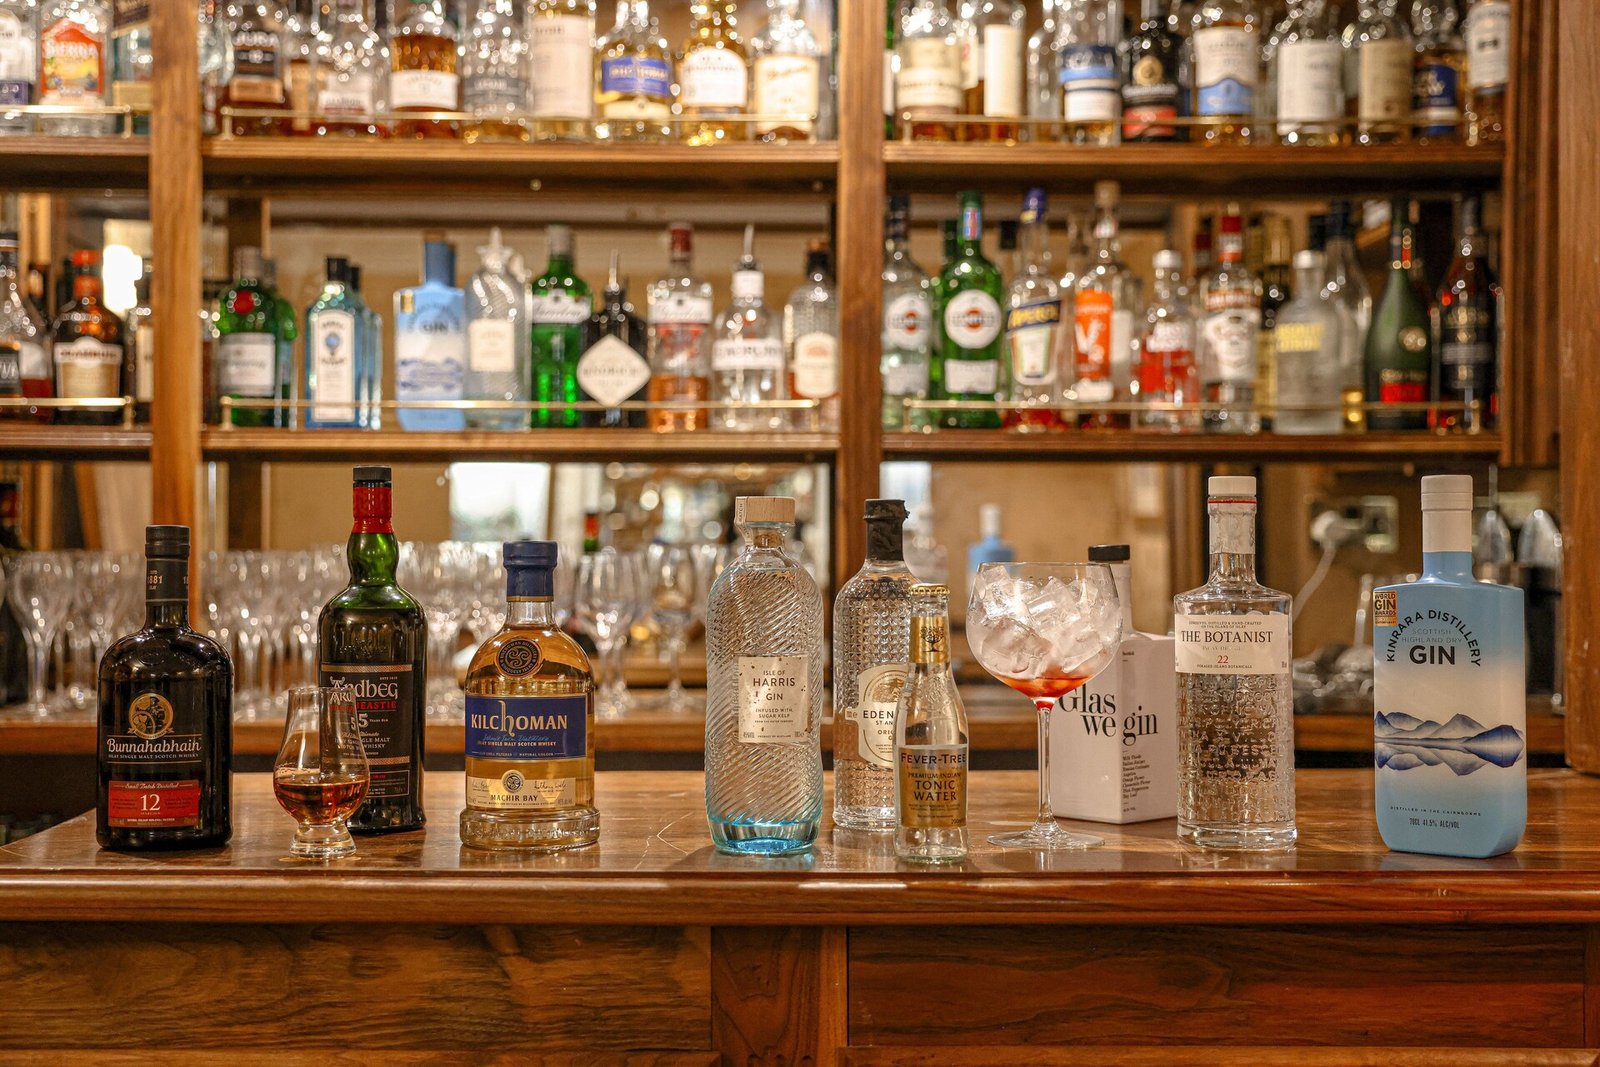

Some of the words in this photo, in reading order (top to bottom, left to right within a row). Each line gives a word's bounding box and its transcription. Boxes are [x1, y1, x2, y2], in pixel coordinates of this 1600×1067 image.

[1374, 599, 1396, 611] GIN
[1181, 630, 1201, 643] THE
[1204, 630, 1273, 643] BOTANIST
[1386, 611, 1424, 662] KINRARA
[1428, 609, 1481, 667] DISTILLERY
[1217, 654, 1229, 664] 22
[1409, 645, 1455, 665] GIN
[753, 677, 796, 687] HARRIS
[766, 693, 783, 701] GIN
[1059, 684, 1116, 714] Glas
[358, 713, 369, 728] 5
[863, 710, 894, 719] EDEN
[1080, 714, 1117, 738] we
[1122, 705, 1158, 746] gin
[106, 738, 202, 753] Bunnahabhain
[901, 752, 966, 764] FEVER-TREE
[914, 780, 955, 790] TONIC
[140, 793, 161, 811] 12
[490, 794, 520, 802] MACHIR
[522, 794, 538, 802] BAY
[913, 791, 957, 801] WATER
